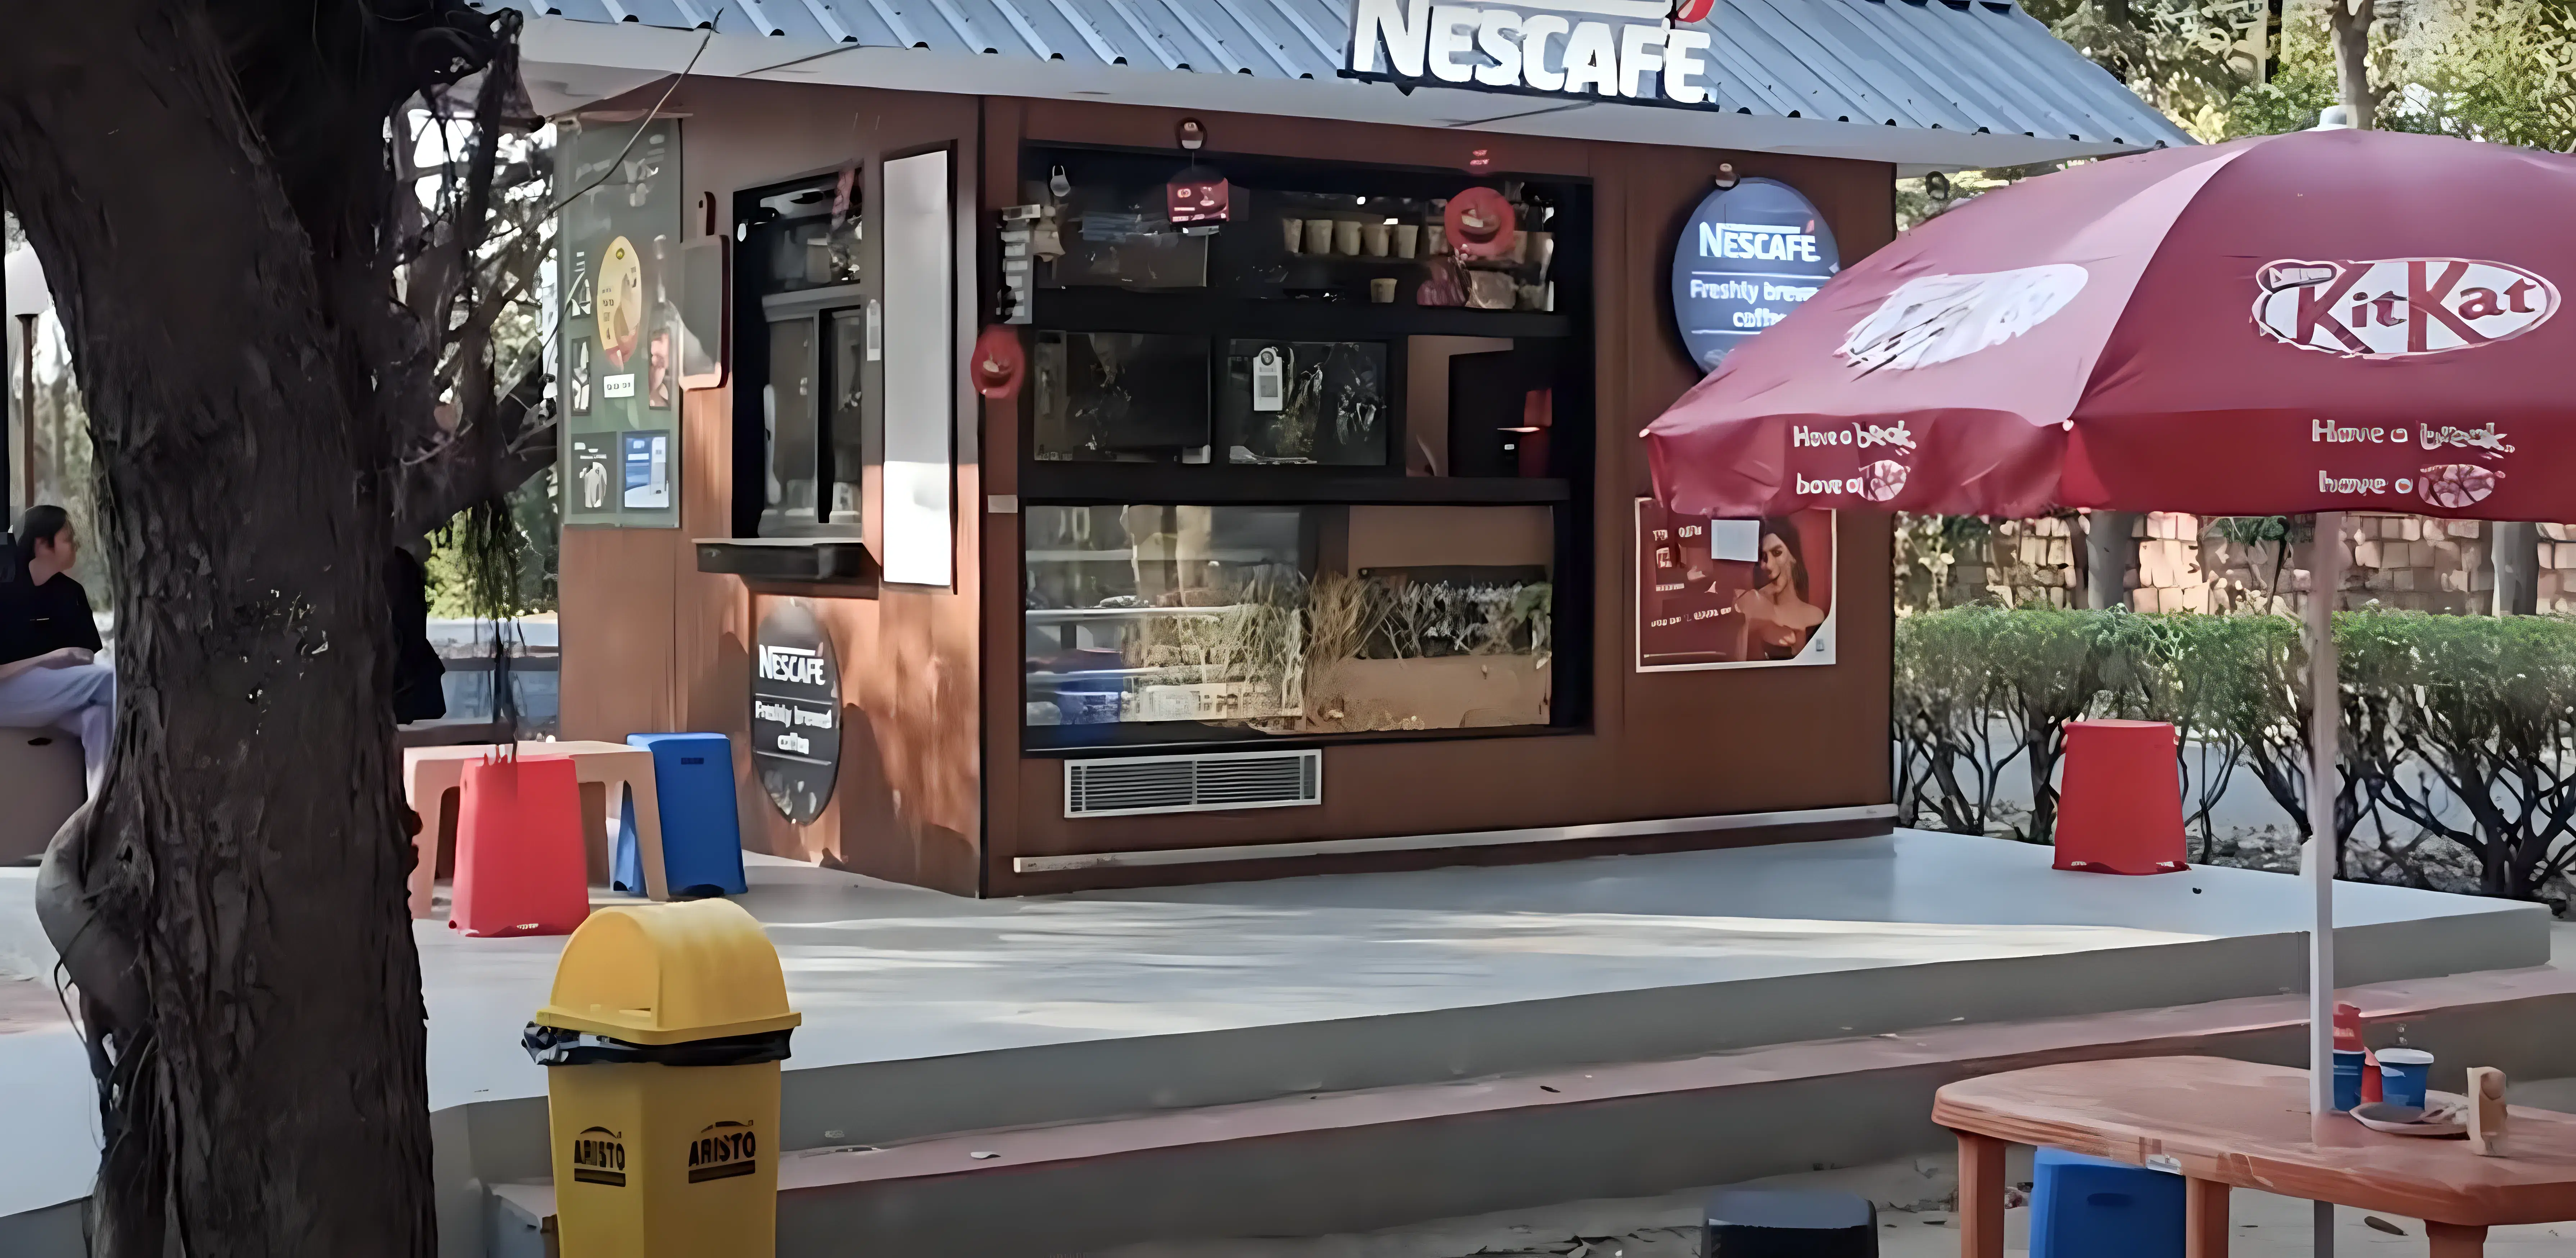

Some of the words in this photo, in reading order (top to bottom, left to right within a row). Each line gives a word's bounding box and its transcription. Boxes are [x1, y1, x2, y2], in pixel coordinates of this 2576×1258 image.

[1690, 279, 1759, 304] Freshly
[2296, 261, 2537, 354] KitKat
[574, 1140, 625, 1171] ARISTO
[689, 1131, 756, 1167] ARISTO
